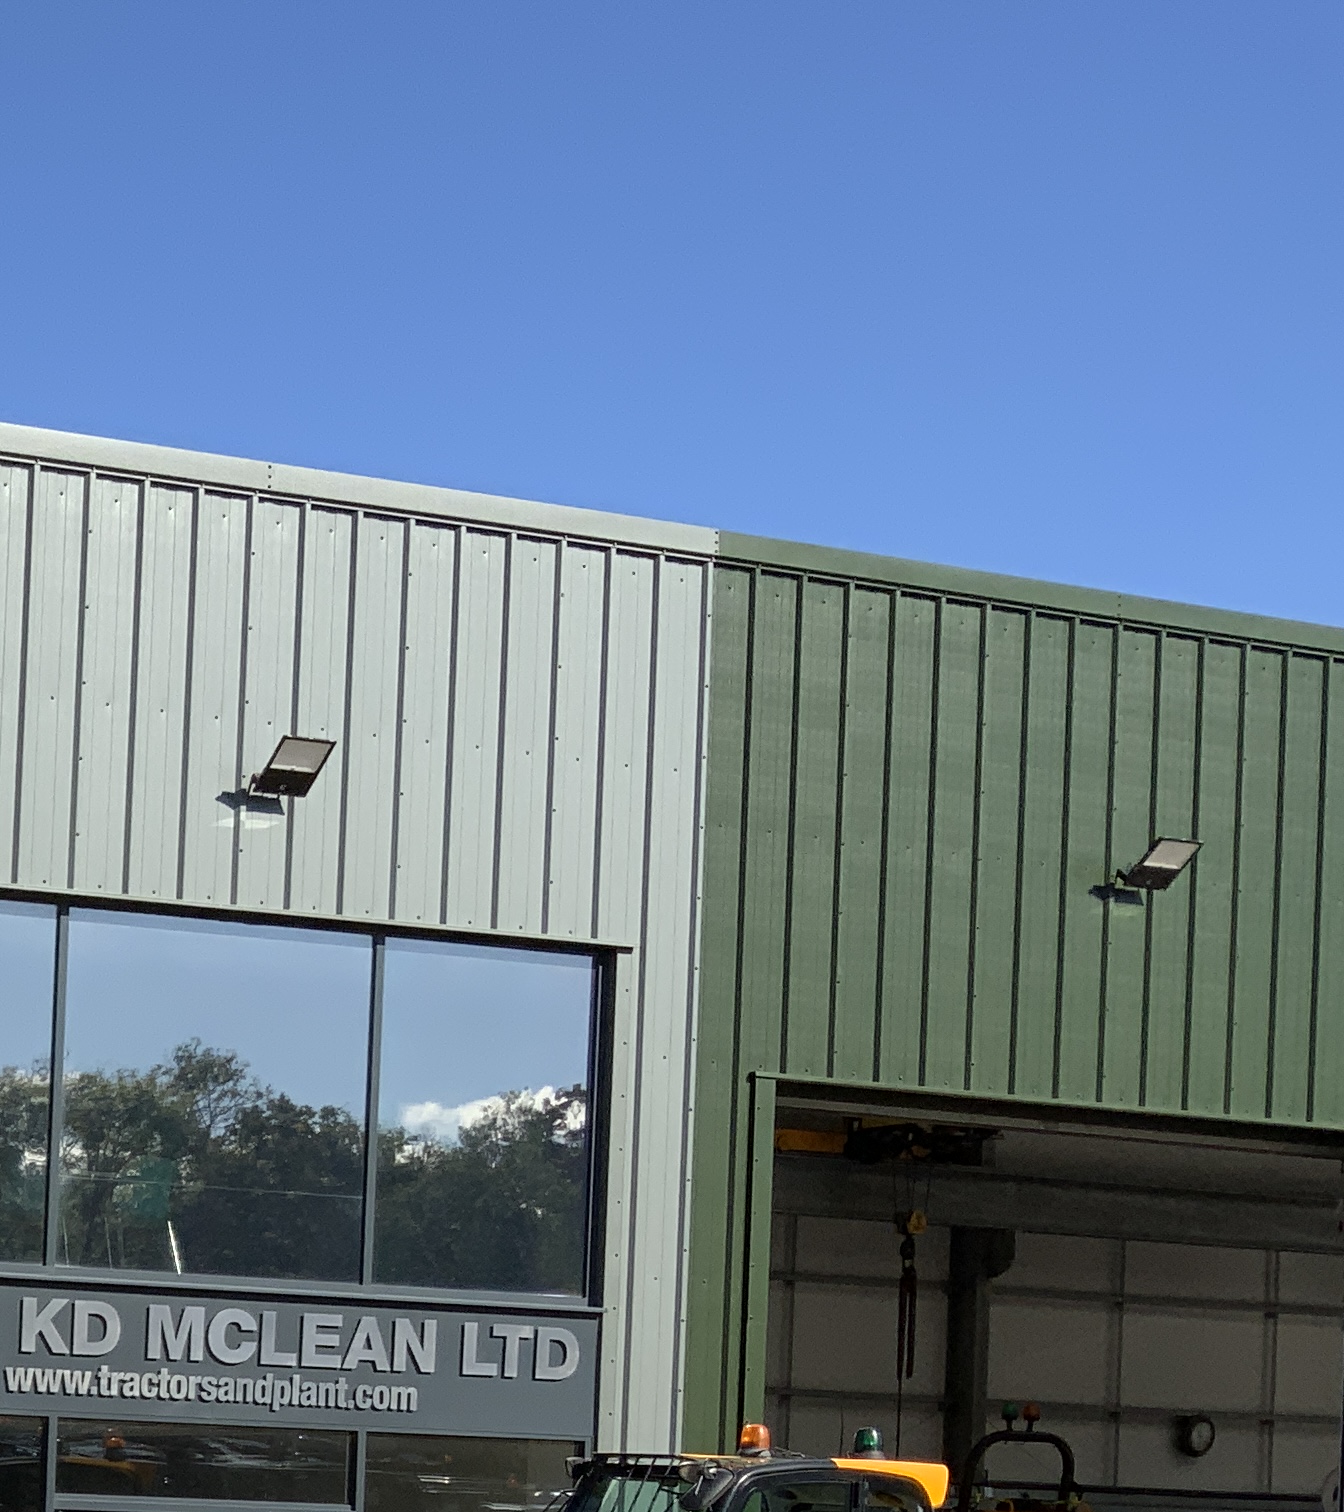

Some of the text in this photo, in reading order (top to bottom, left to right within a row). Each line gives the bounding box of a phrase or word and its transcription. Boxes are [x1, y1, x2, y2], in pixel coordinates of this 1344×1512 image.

[19, 1297, 121, 1357] KD
[145, 1304, 437, 1373] MCLEAN
[460, 1322, 579, 1381] LTD
[4, 1364, 418, 1412] www.tractorsandplant.com
